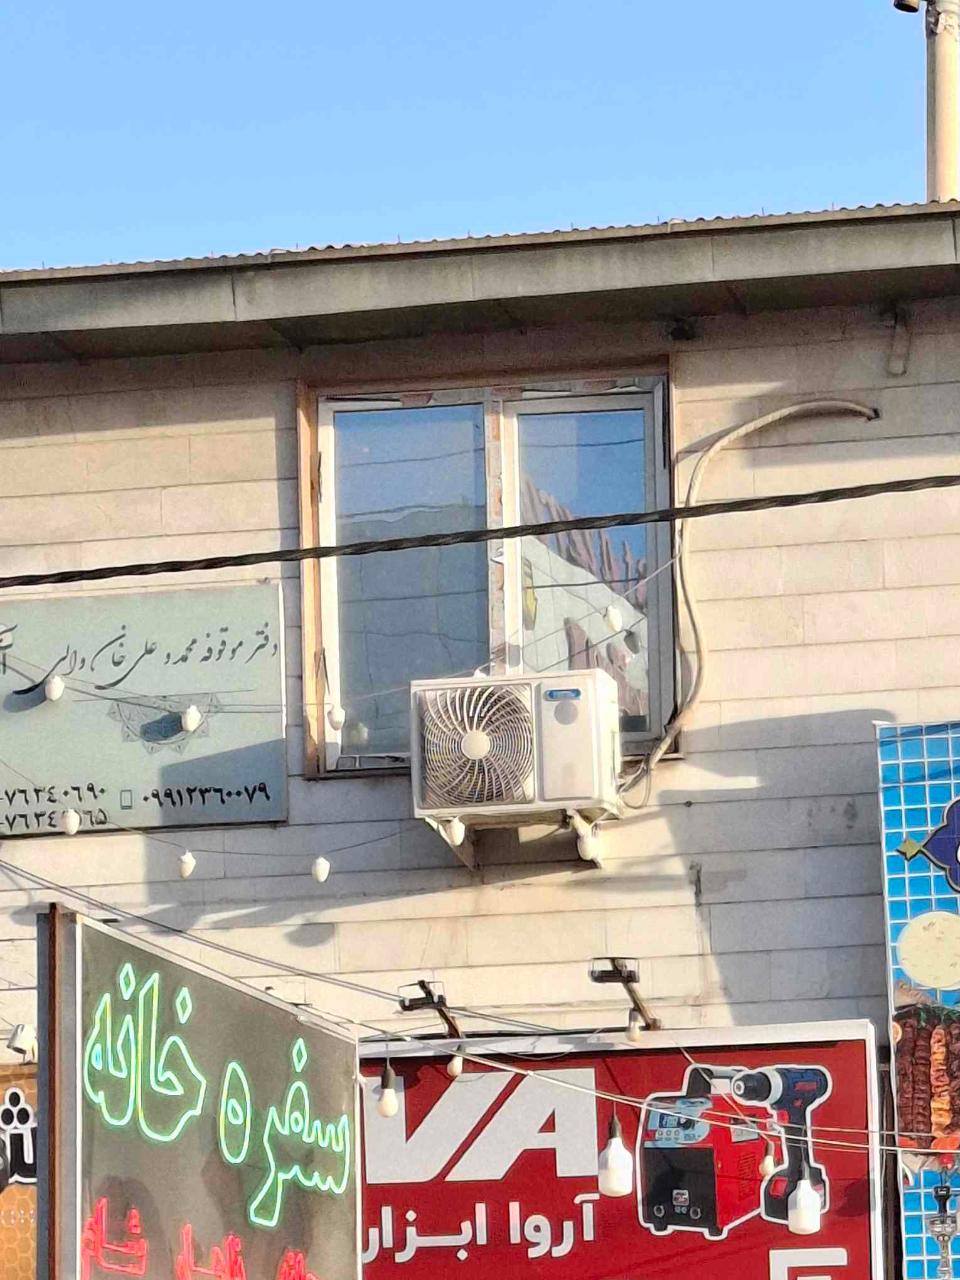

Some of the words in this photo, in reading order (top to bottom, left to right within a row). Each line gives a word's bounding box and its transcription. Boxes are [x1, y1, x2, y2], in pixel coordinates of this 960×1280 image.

[91, 624, 127, 672] خان
[200, 626, 244, 662] موقوفه
[245, 622, 278, 664] دفتر
[83, 962, 207, 1142] خانه
[218, 1038, 351, 1228] سفره
[365, 1067, 600, 1184] VA
[362, 1201, 487, 1264] ابزار
[509, 1193, 600, 1258] آروا
